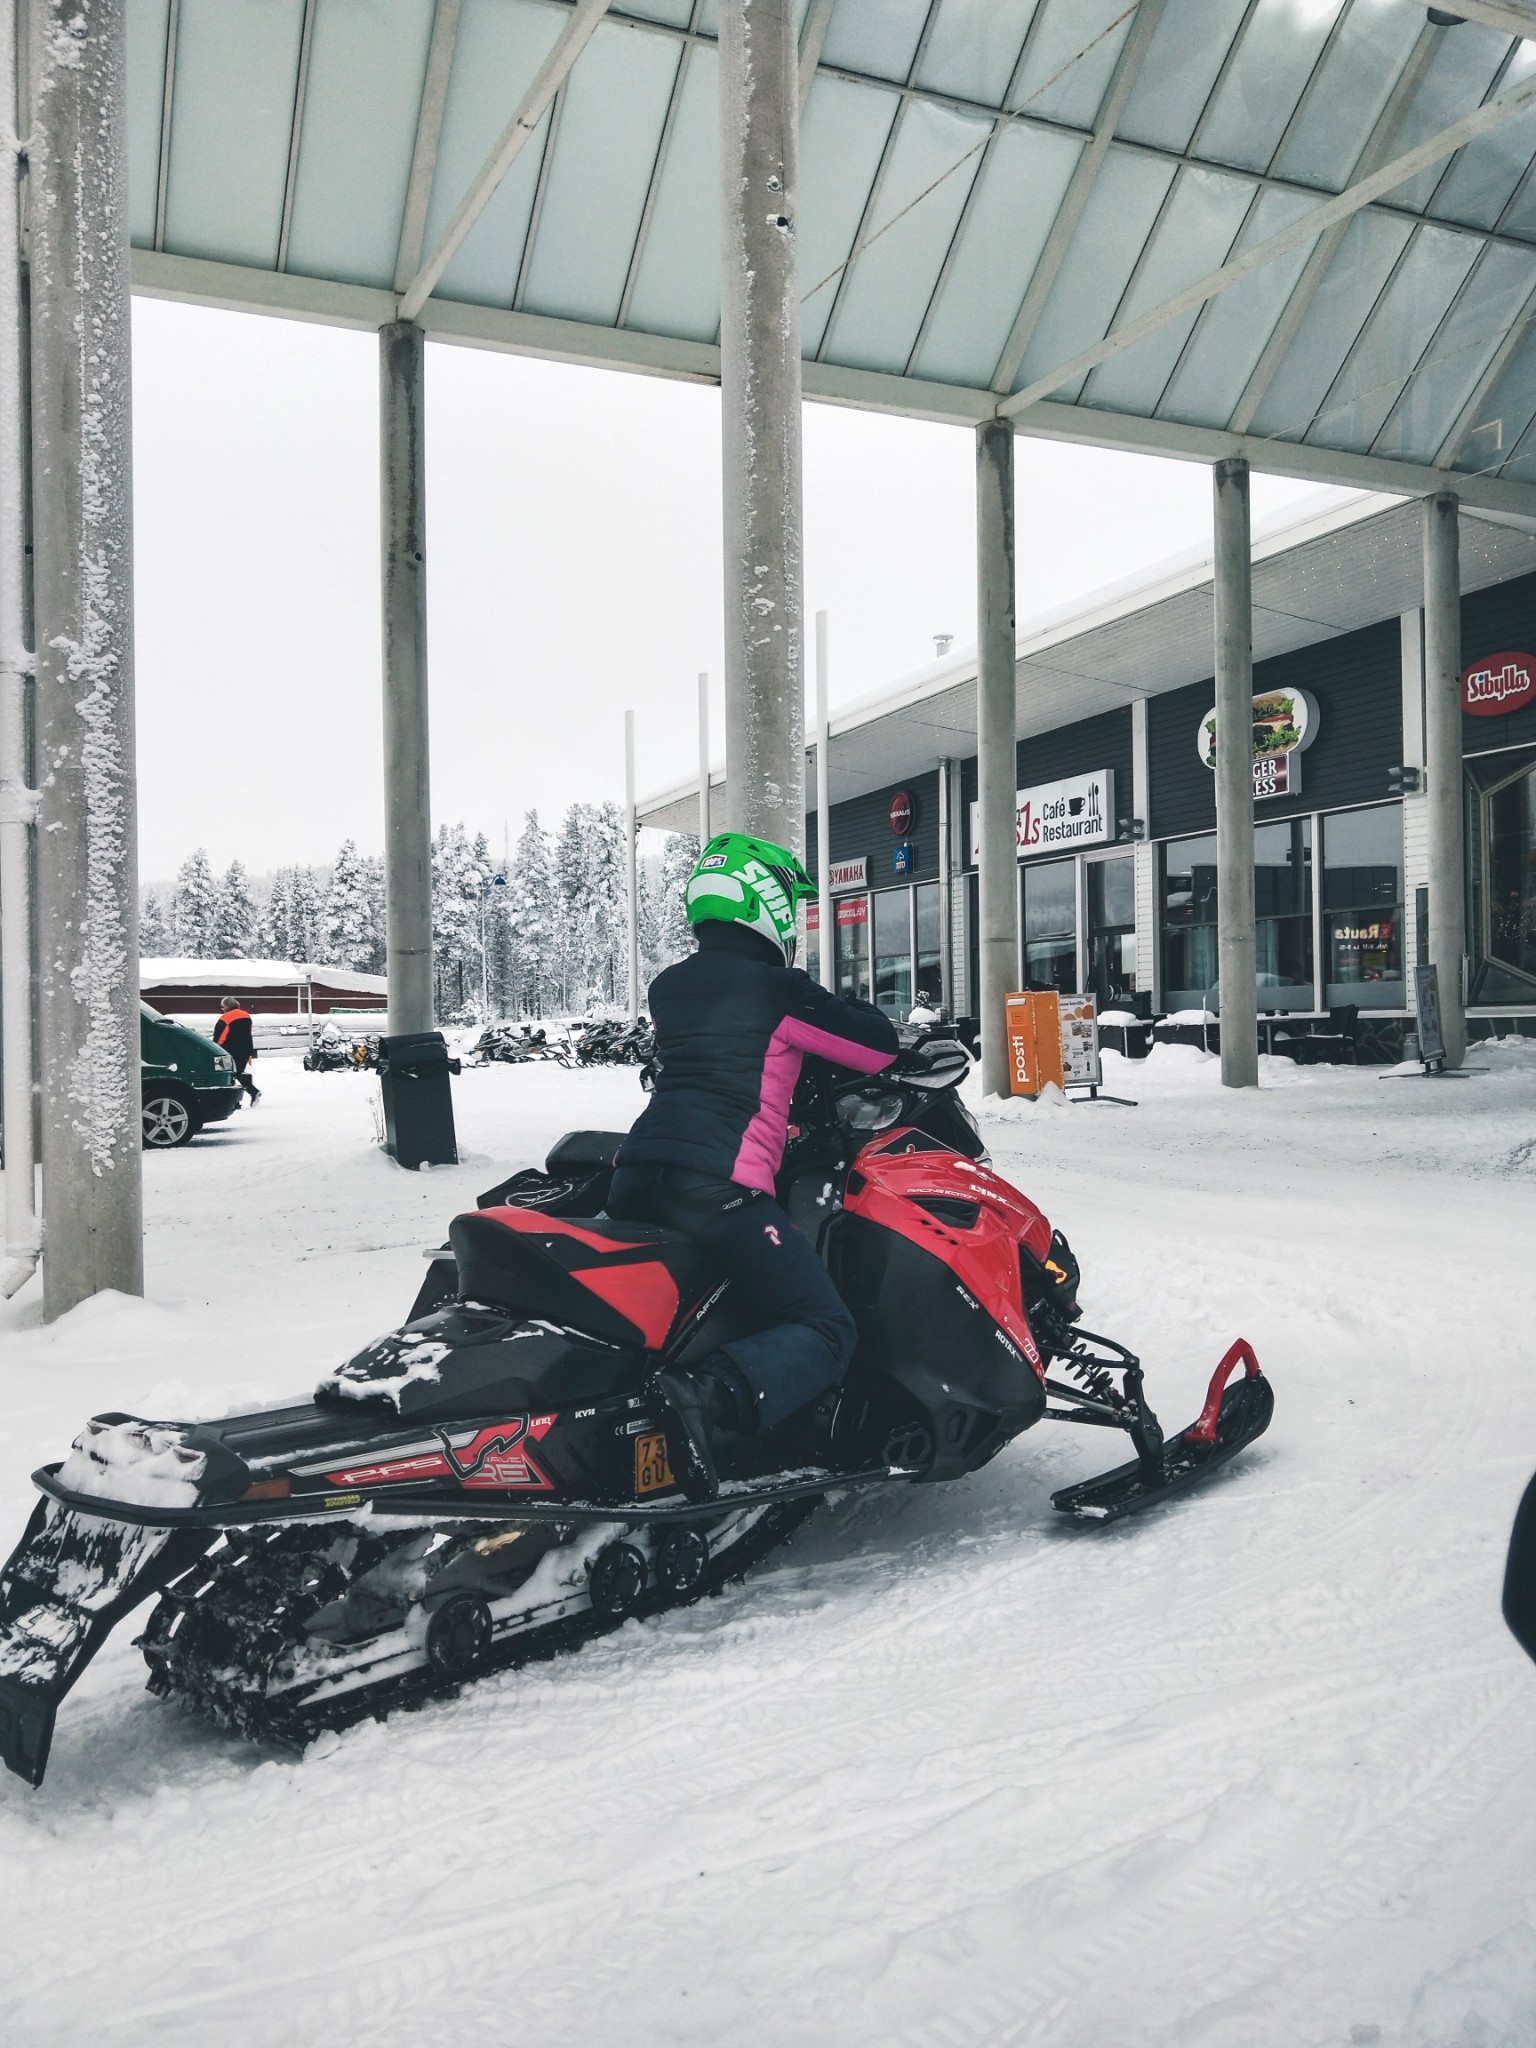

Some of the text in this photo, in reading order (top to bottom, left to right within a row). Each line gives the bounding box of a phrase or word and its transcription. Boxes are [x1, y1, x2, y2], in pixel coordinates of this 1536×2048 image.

[1467, 664, 1531, 702] Sibylla
[1253, 759, 1277, 778] GER
[1253, 777, 1277, 797] ESS
[1043, 797, 1065, 820] Café
[1043, 814, 1103, 843] Restaurant
[834, 864, 864, 885] YAMAHA
[730, 860, 796, 941] SHIFT
[1012, 1035, 1030, 1083] posti
[907, 1187, 977, 1201] RACING EDITION
[969, 1184, 1008, 1205] LYNX
[995, 1329, 1017, 1358] ROTAX
